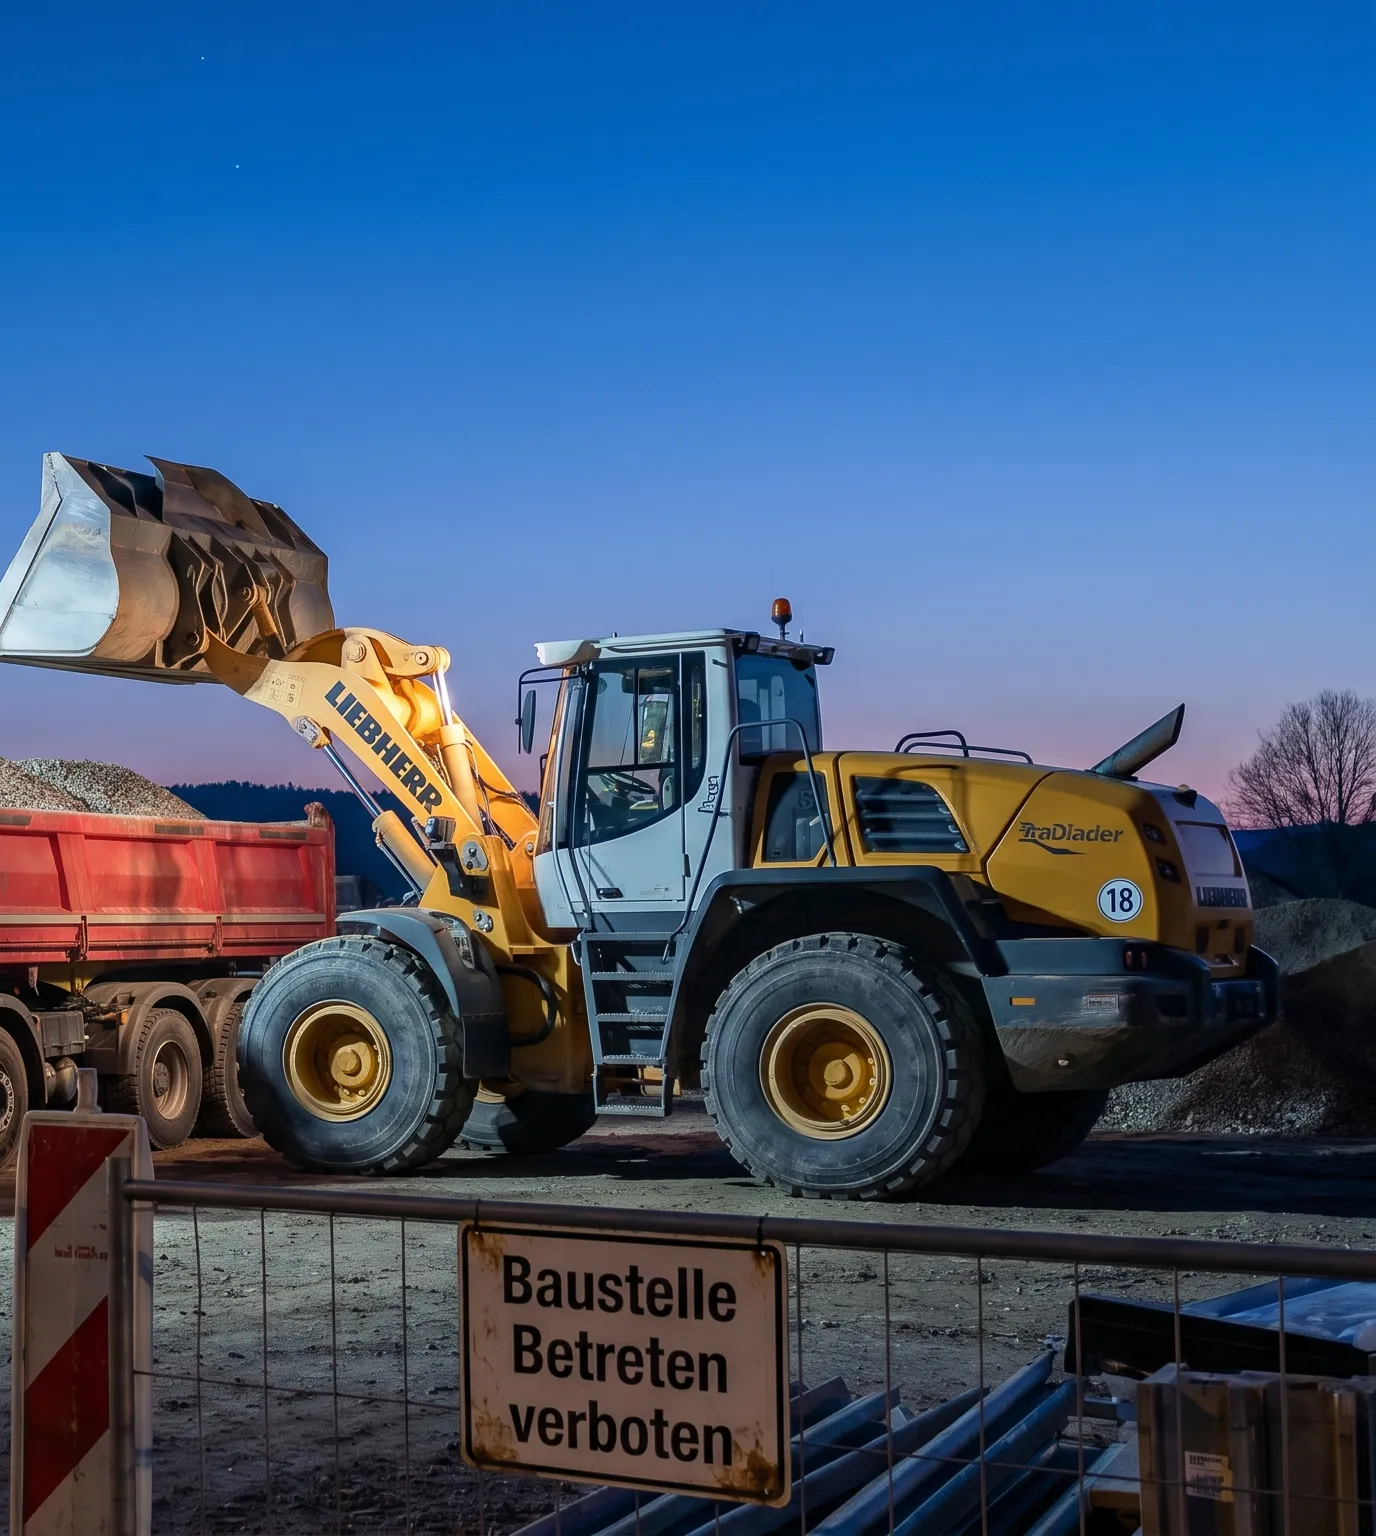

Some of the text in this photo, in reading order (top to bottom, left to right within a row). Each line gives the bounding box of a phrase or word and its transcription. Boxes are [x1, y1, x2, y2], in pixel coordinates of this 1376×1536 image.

[324, 680, 443, 815] LIEBHERR
[1106, 887, 1134, 913] 18
[503, 1255, 737, 1323] Baustelle
[513, 1324, 728, 1394] Betreten
[508, 1400, 733, 1467] verboten
